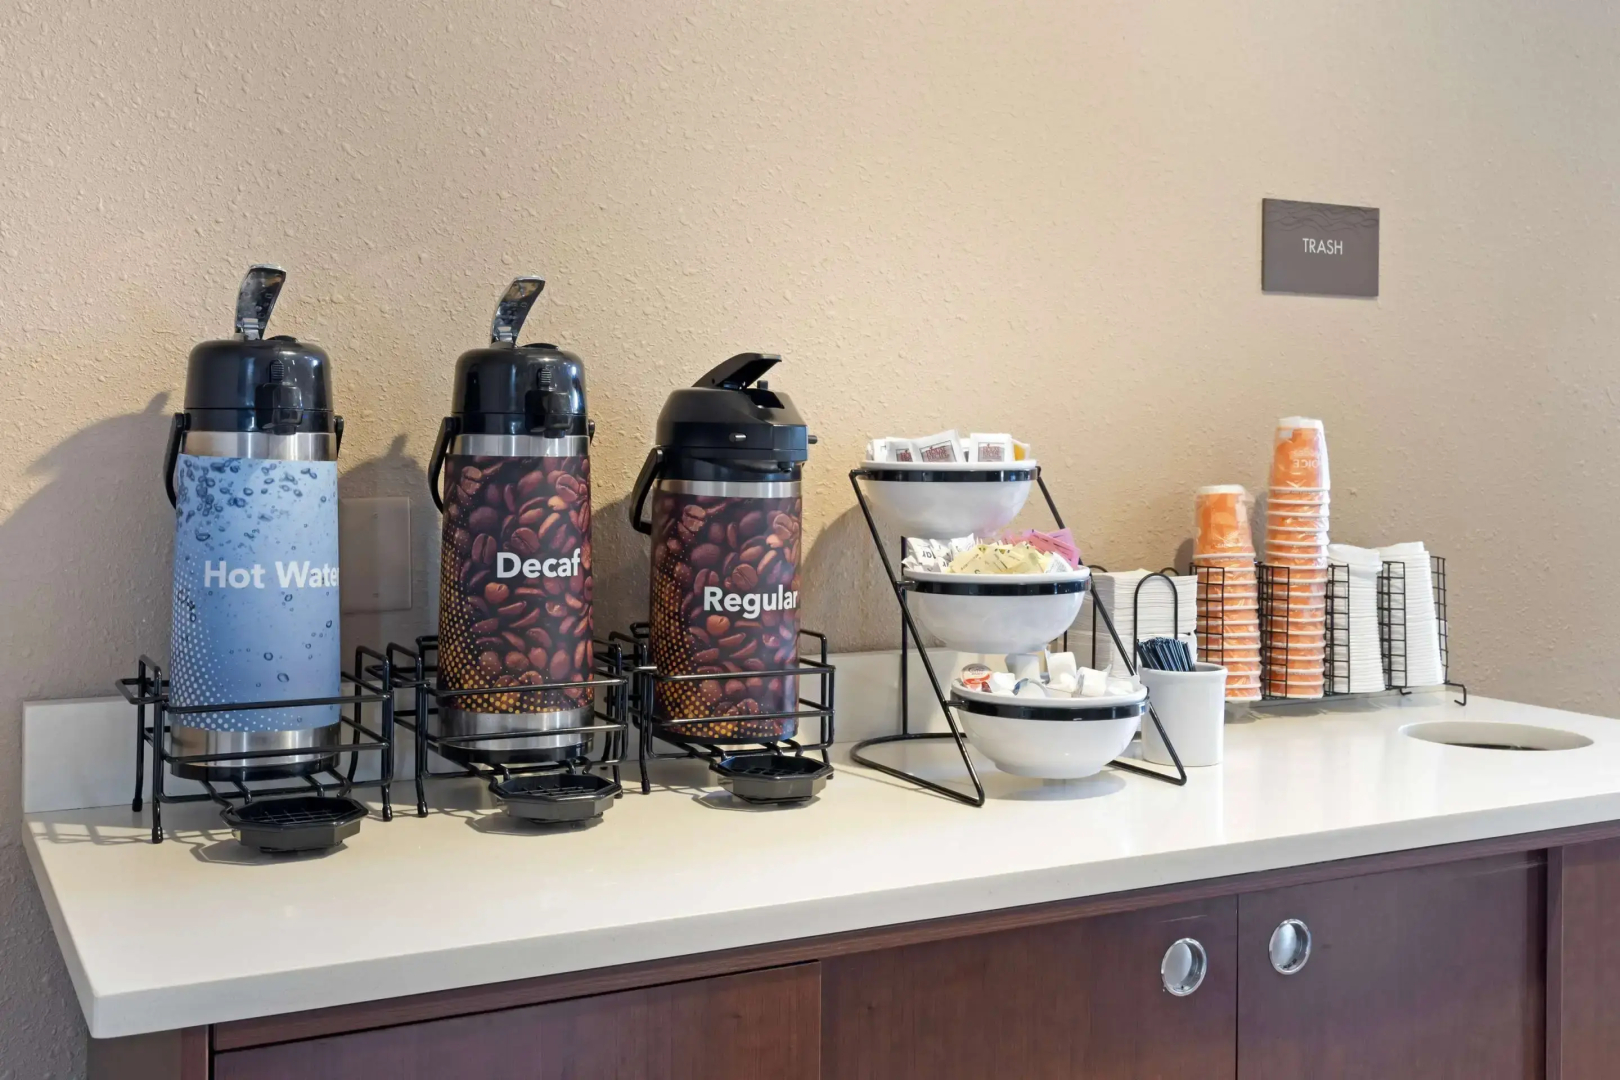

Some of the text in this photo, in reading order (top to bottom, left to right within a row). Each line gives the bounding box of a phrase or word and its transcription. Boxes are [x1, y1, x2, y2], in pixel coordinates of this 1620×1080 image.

[1302, 237, 1344, 256] TRASH
[204, 560, 266, 589] Hot
[496, 548, 581, 579] Decaf
[703, 584, 798, 619] Regular
